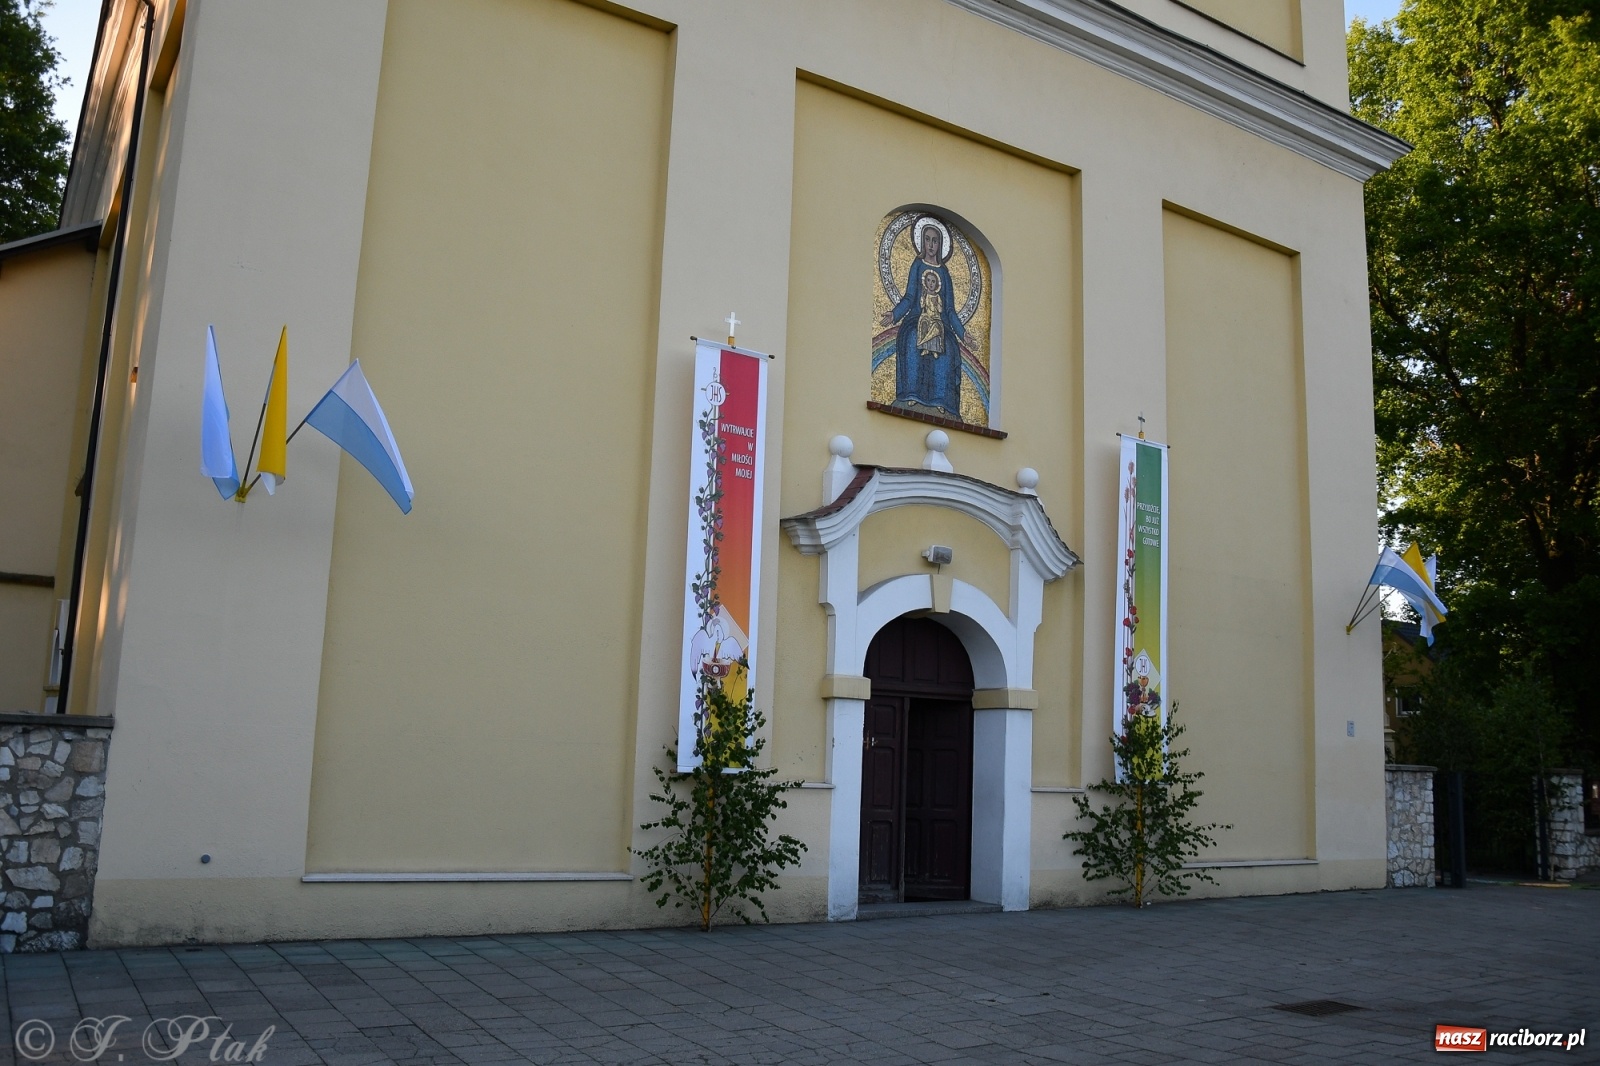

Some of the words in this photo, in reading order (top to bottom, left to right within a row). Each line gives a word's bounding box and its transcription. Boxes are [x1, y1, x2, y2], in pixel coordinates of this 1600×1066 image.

[721, 423, 754, 438] WYTRWAJCIE
[747, 442, 754, 451] W
[731, 453, 753, 465] MIŁOŚCI
[735, 468, 753, 479] MOJEJ
[1138, 525, 1160, 536] WSZYSTKO
